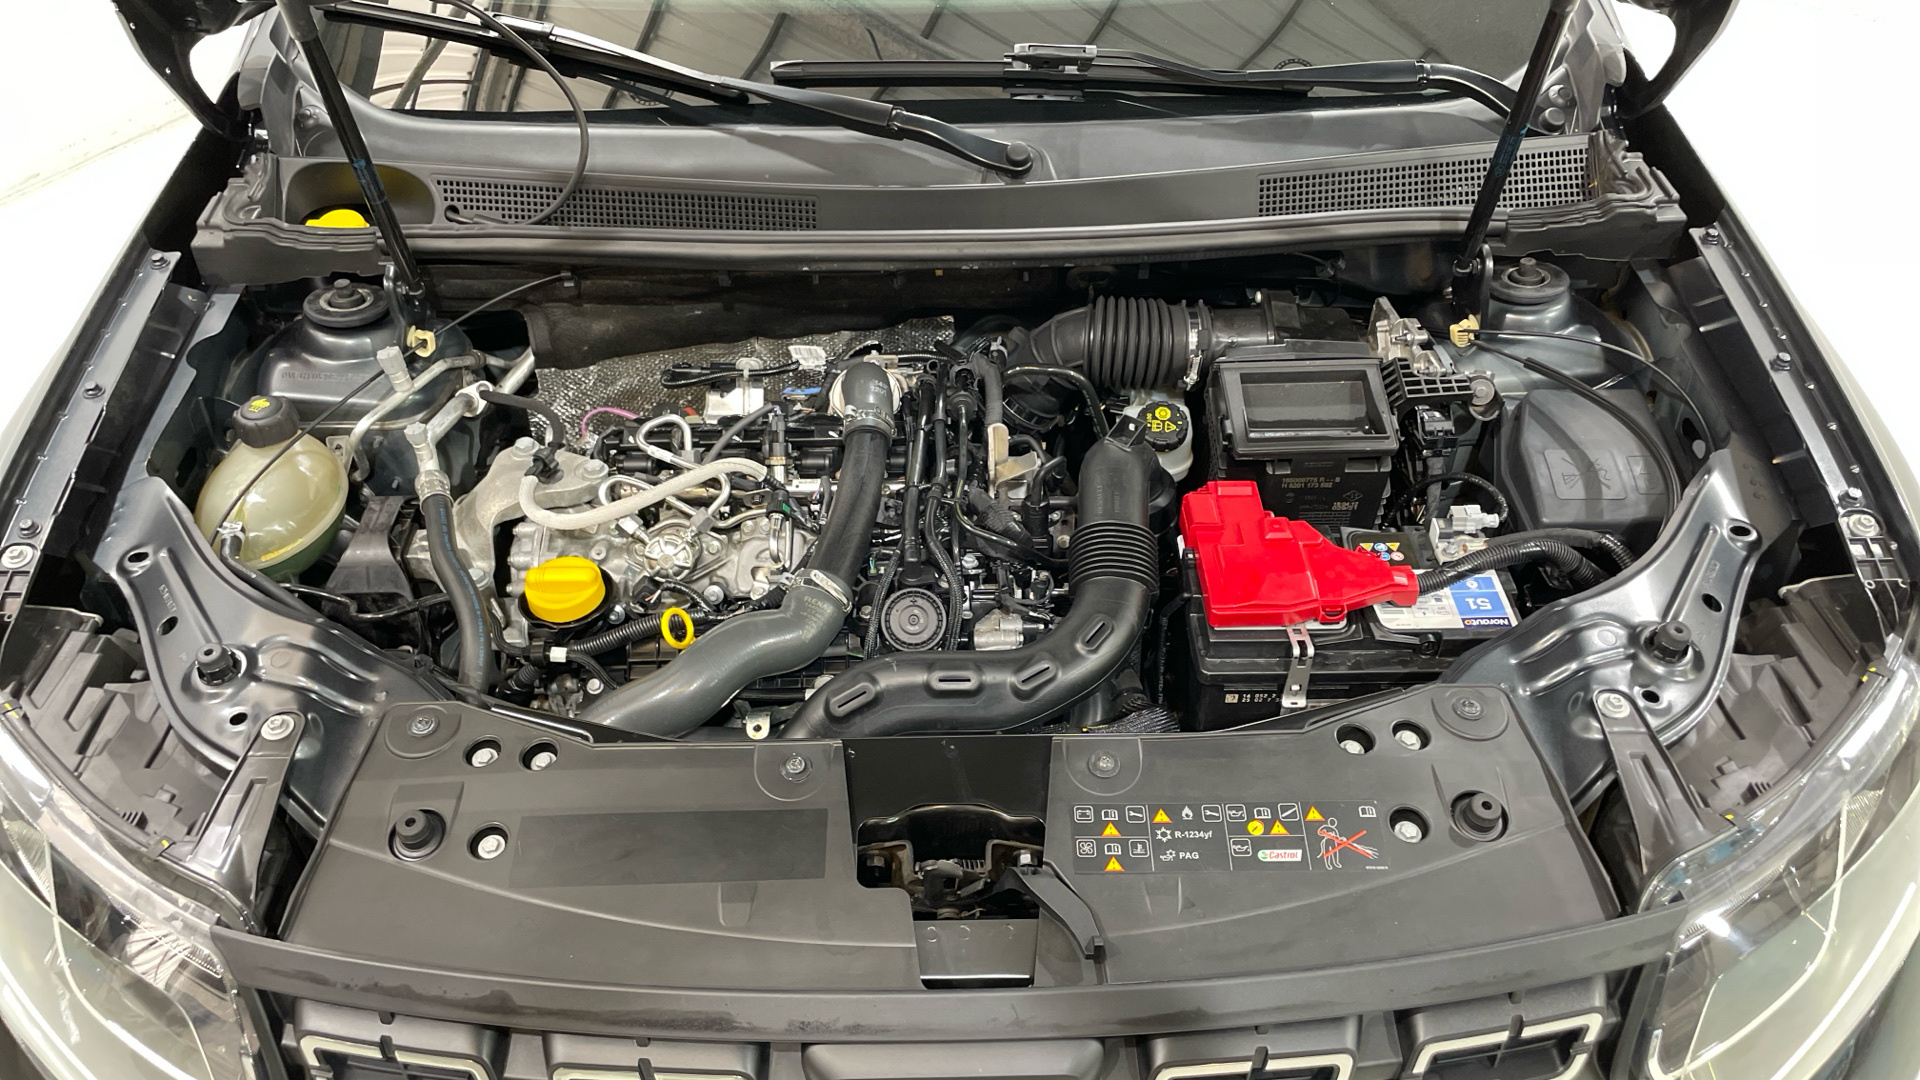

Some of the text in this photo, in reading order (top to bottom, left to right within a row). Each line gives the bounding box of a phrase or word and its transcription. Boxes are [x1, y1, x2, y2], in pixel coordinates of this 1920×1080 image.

[1466, 597, 1493, 611] 51
[1464, 618, 1509, 626] Norauto
[1174, 830, 1213, 840] R-1234yf
[1179, 852, 1200, 860] PAG
[1268, 850, 1299, 860] Castrol
